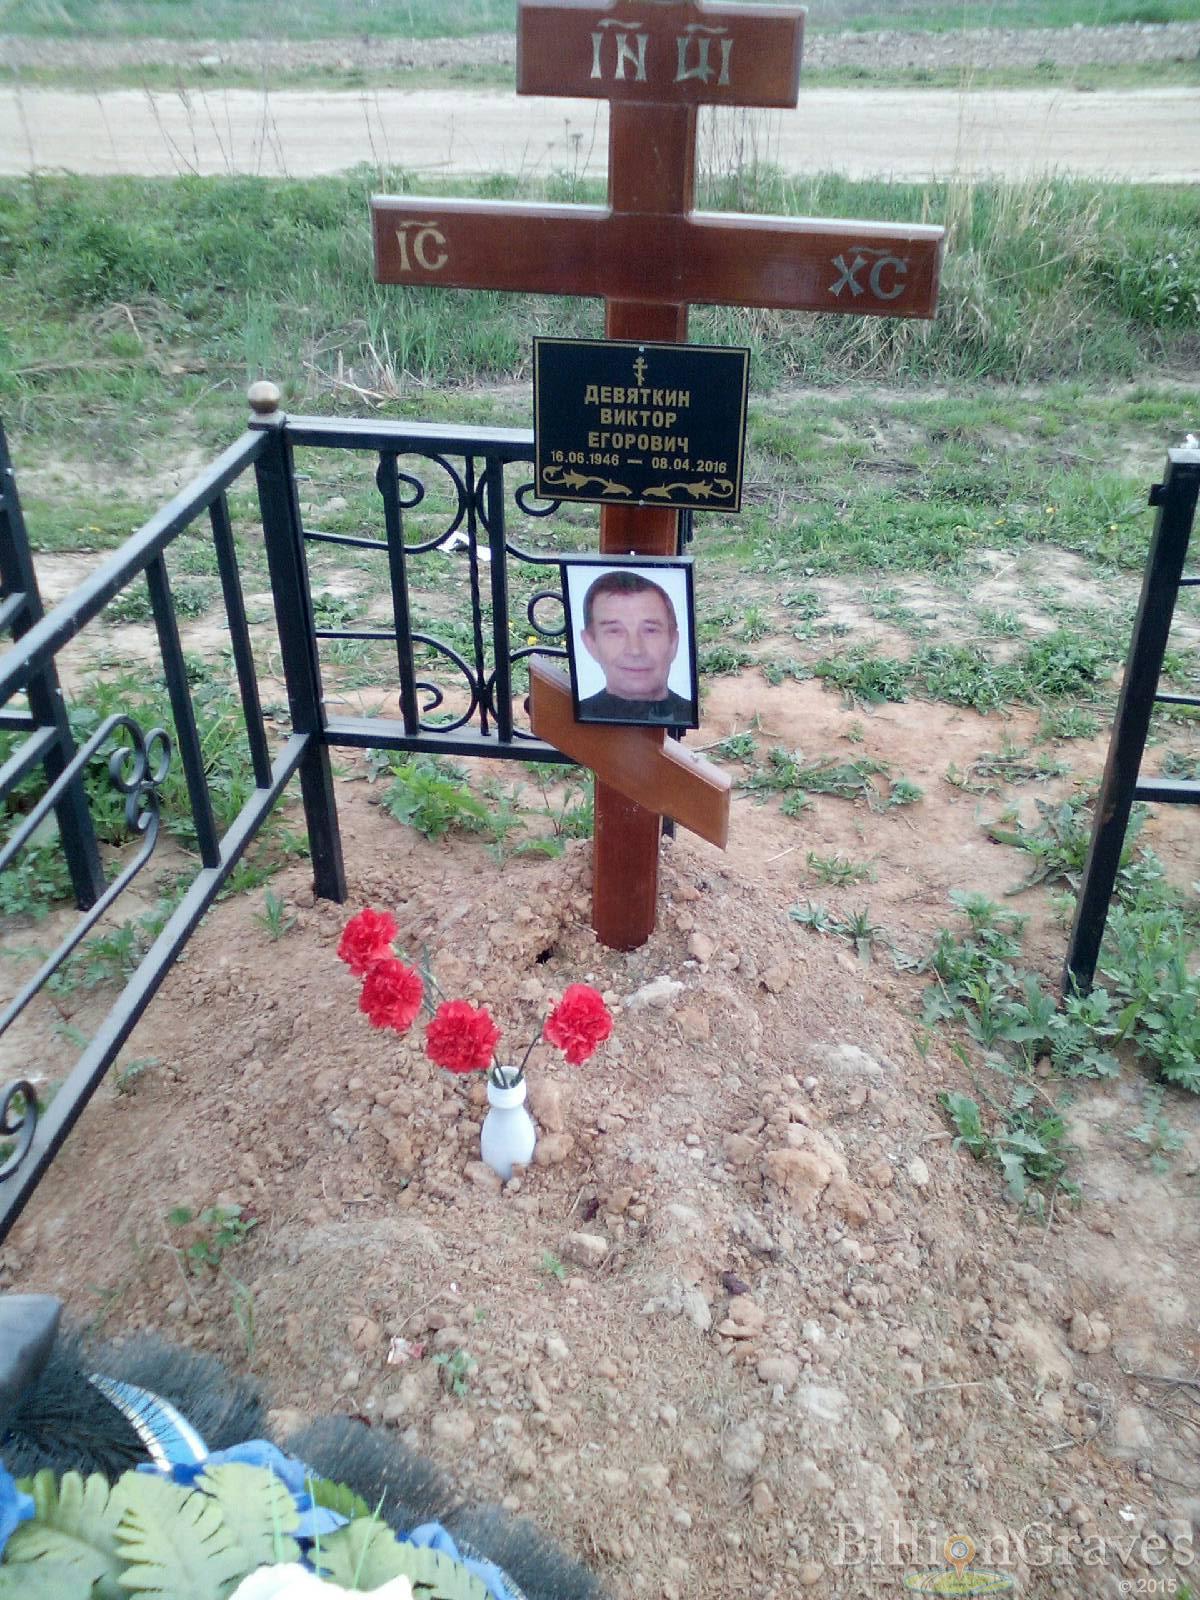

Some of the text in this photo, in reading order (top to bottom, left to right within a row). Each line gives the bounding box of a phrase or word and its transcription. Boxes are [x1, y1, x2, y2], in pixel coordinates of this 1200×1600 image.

[584, 384, 690, 408] ДЕВЯТКИН
[600, 408, 677, 429] ВИКТОР
[588, 431, 689, 454] ЕГОРОВИЧ
